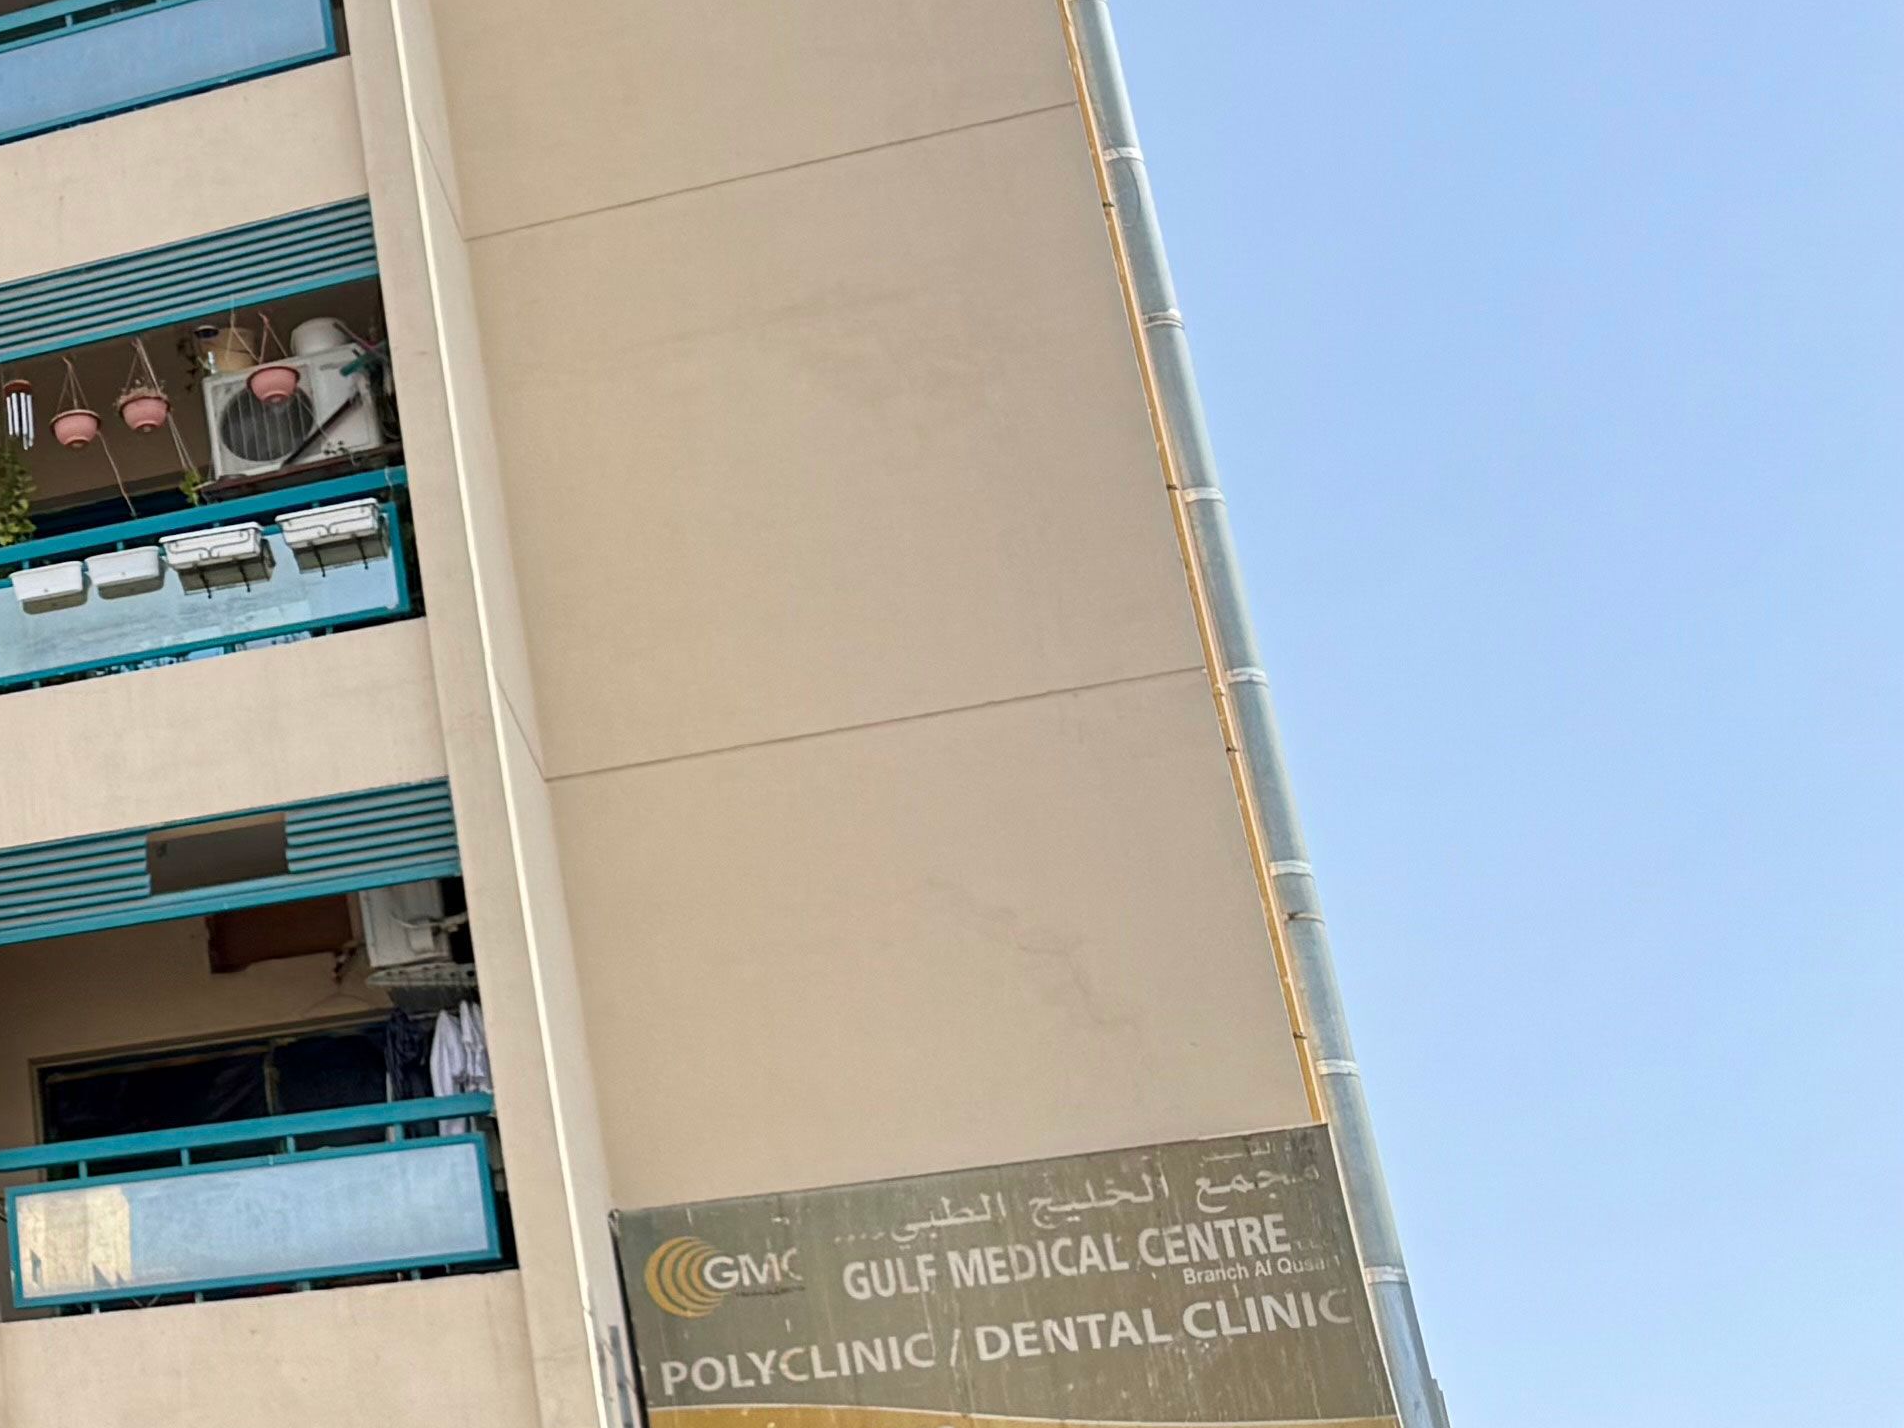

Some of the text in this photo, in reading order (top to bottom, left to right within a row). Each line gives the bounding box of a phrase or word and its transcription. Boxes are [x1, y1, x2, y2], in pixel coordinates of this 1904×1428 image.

[891, 1191, 1006, 1243] الطبي
[1029, 1155, 1169, 1228] الخليج
[703, 1247, 803, 1290] GMC
[843, 1213, 1291, 1301] GULF MEDICAL CENTRE
[1183, 1260, 1249, 1284] Branch
[1255, 1260, 1273, 1277] Al
[661, 1332, 935, 1397] POLYCLINIC
[977, 1308, 1172, 1361] DENTAL
[1182, 1287, 1353, 1341] CLINIC
